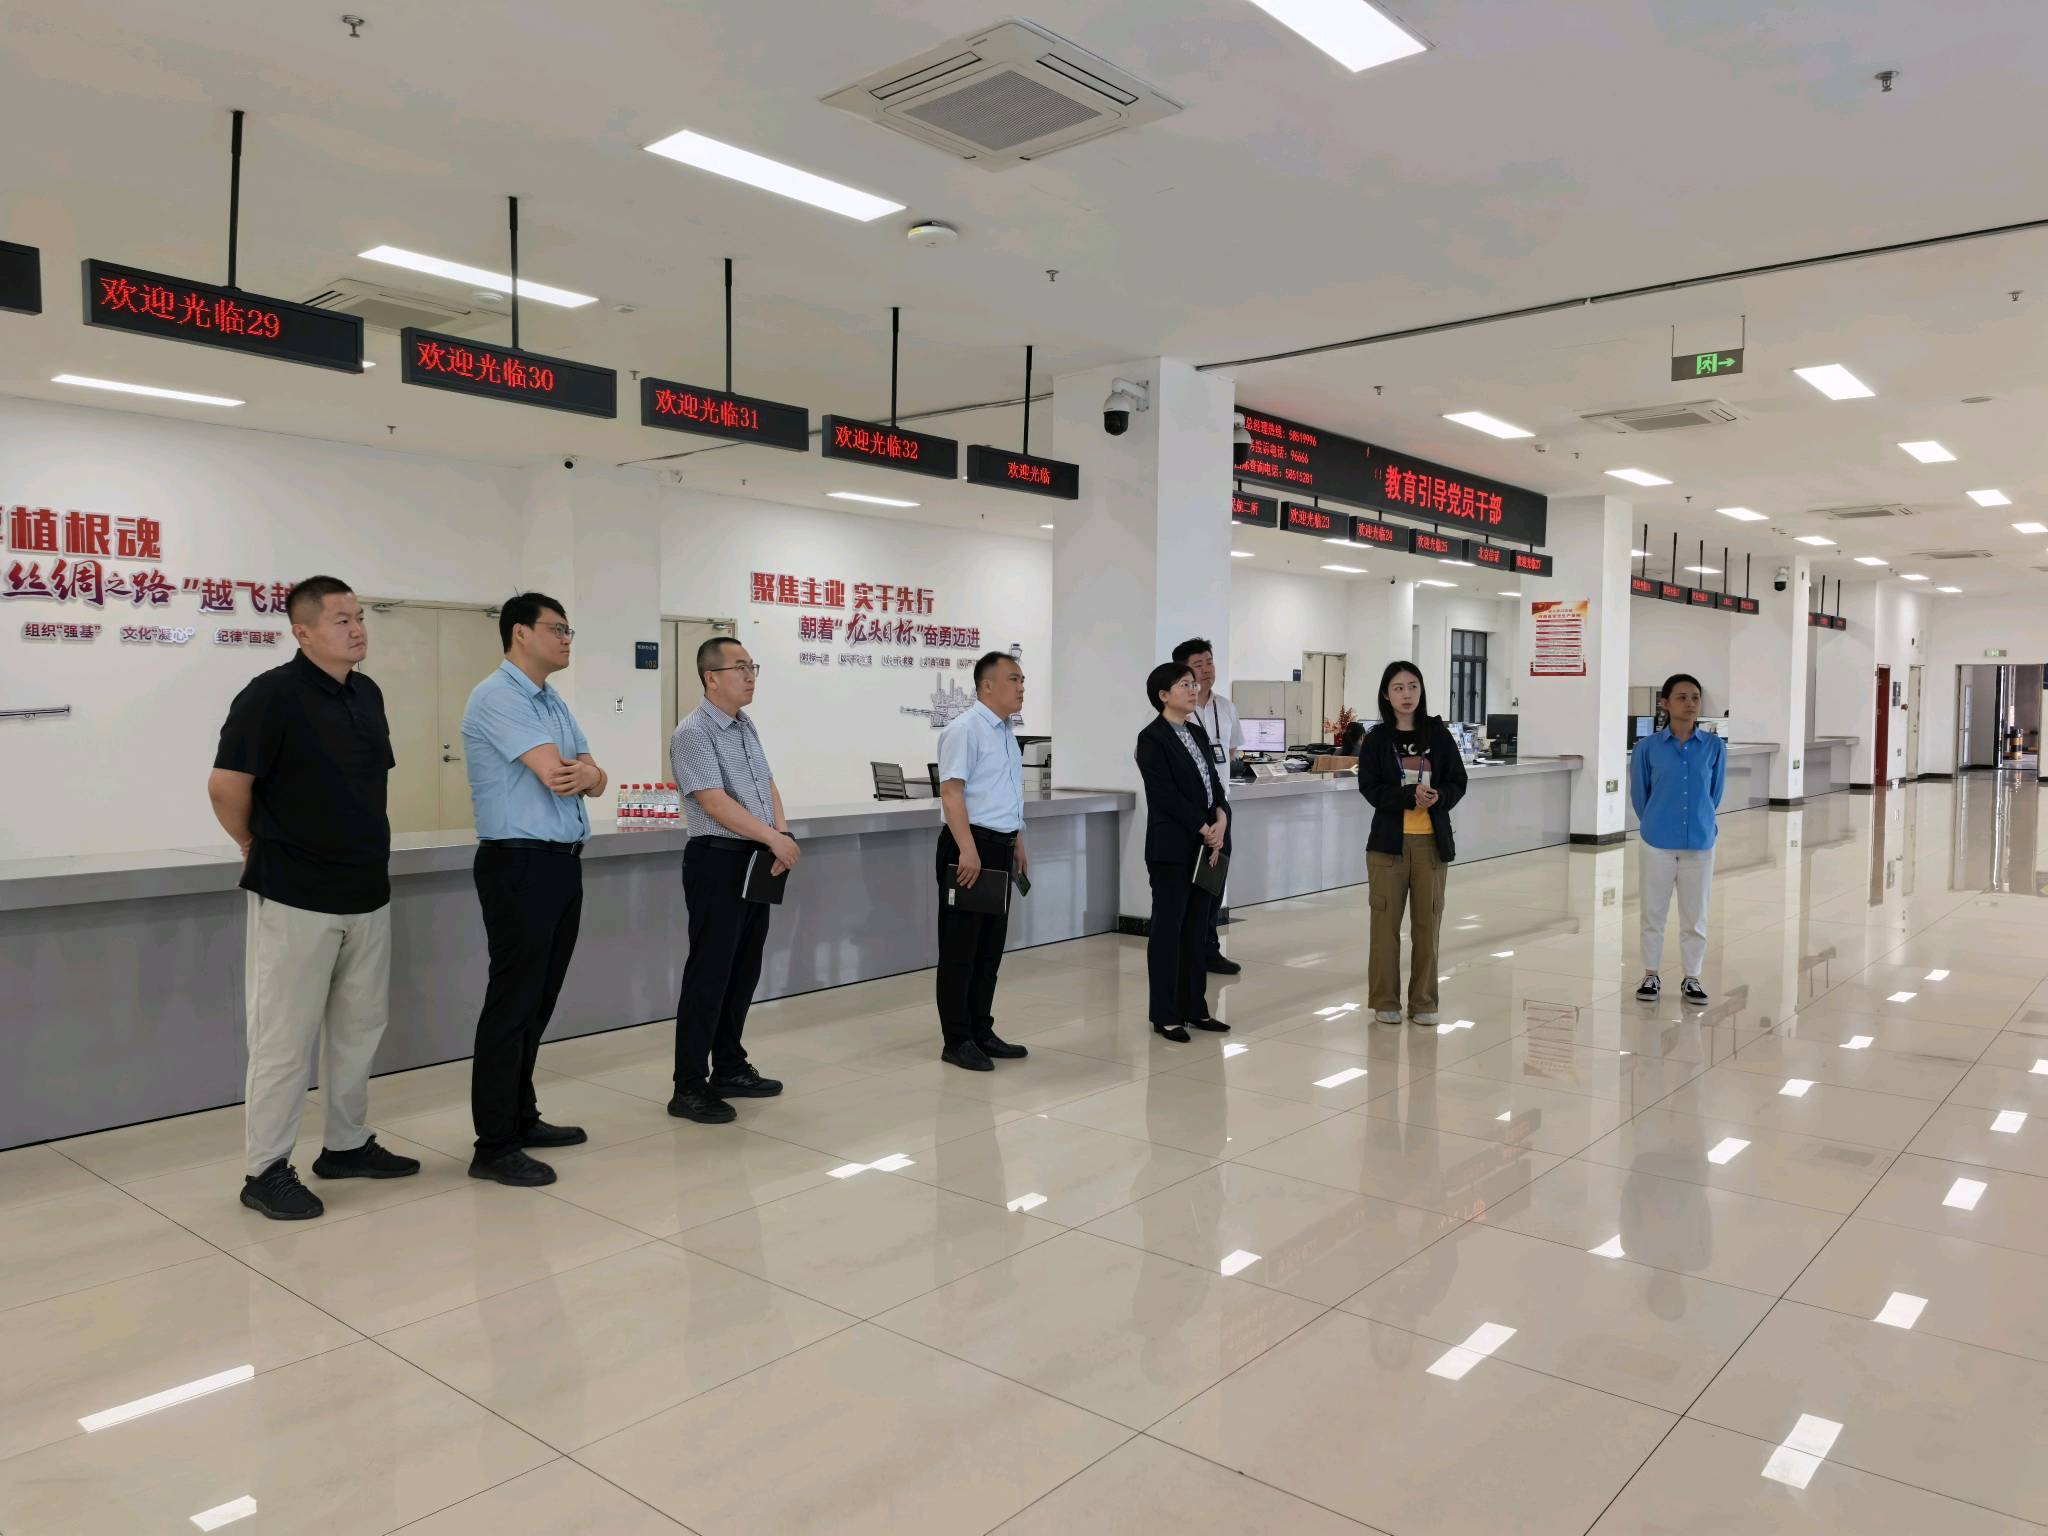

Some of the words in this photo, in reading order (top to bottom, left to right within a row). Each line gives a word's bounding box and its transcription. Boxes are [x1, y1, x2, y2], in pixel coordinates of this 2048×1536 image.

[100, 277, 280, 339] 欢迎光临29
[417, 341, 554, 392] 欢迎光临30
[655, 388, 759, 431] 欢迎光临31
[834, 424, 919, 461] 欢迎光临32
[1007, 461, 1051, 486] 欢迎光临
[1384, 464, 1504, 526] 教育引导党员干部
[0, 506, 162, 560] 植根魂
[1289, 507, 1330, 529] 欢迎光临23
[1357, 522, 1393, 542] 欢迎光临24
[752, 571, 845, 609] 聚焦主业
[852, 582, 935, 615] 实干先行
[24, 622, 101, 639] 组织“强基”
[121, 625, 195, 643] 文化“凝心”
